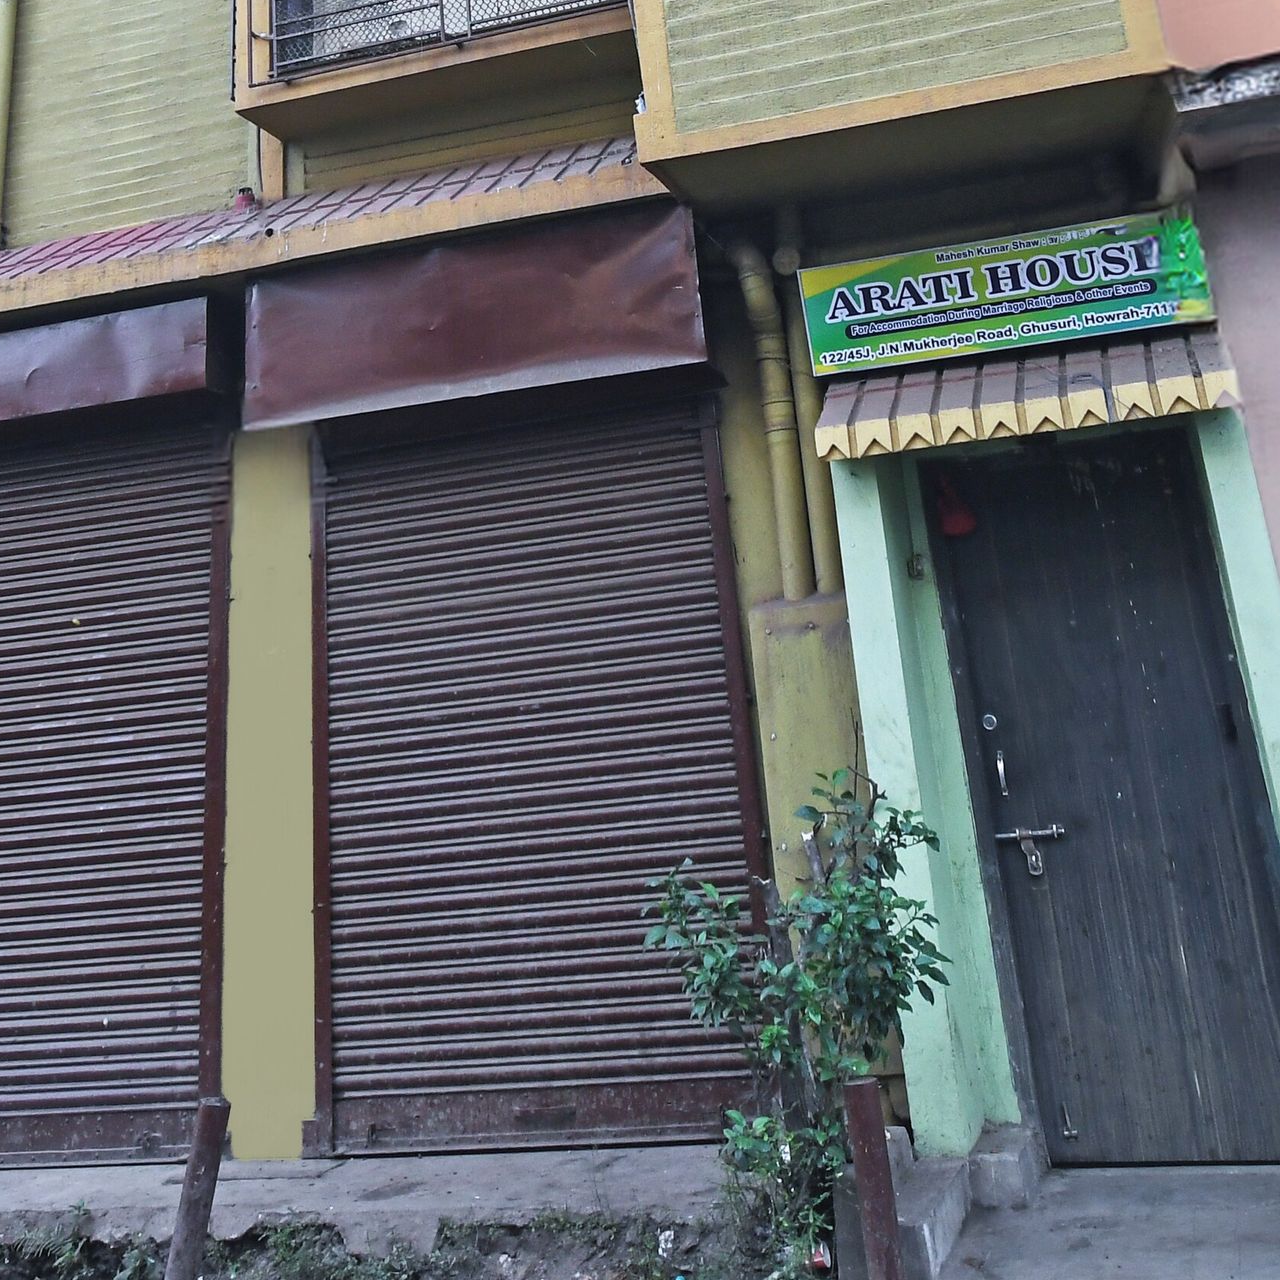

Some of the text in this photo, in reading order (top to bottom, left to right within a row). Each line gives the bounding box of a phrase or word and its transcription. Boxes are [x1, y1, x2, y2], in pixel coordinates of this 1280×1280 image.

[936, 238, 1040, 263] Mahesh Kumar Shaw
[827, 270, 976, 321] ARATI
[851, 282, 1150, 337] For Accommodation During Marriage Religious & other Events
[820, 347, 875, 365] 122/45J,
[877, 334, 974, 358] J.N.Mukherjee
[976, 326, 1018, 342] Road,
[1020, 317, 1082, 336] Ghusuri,
